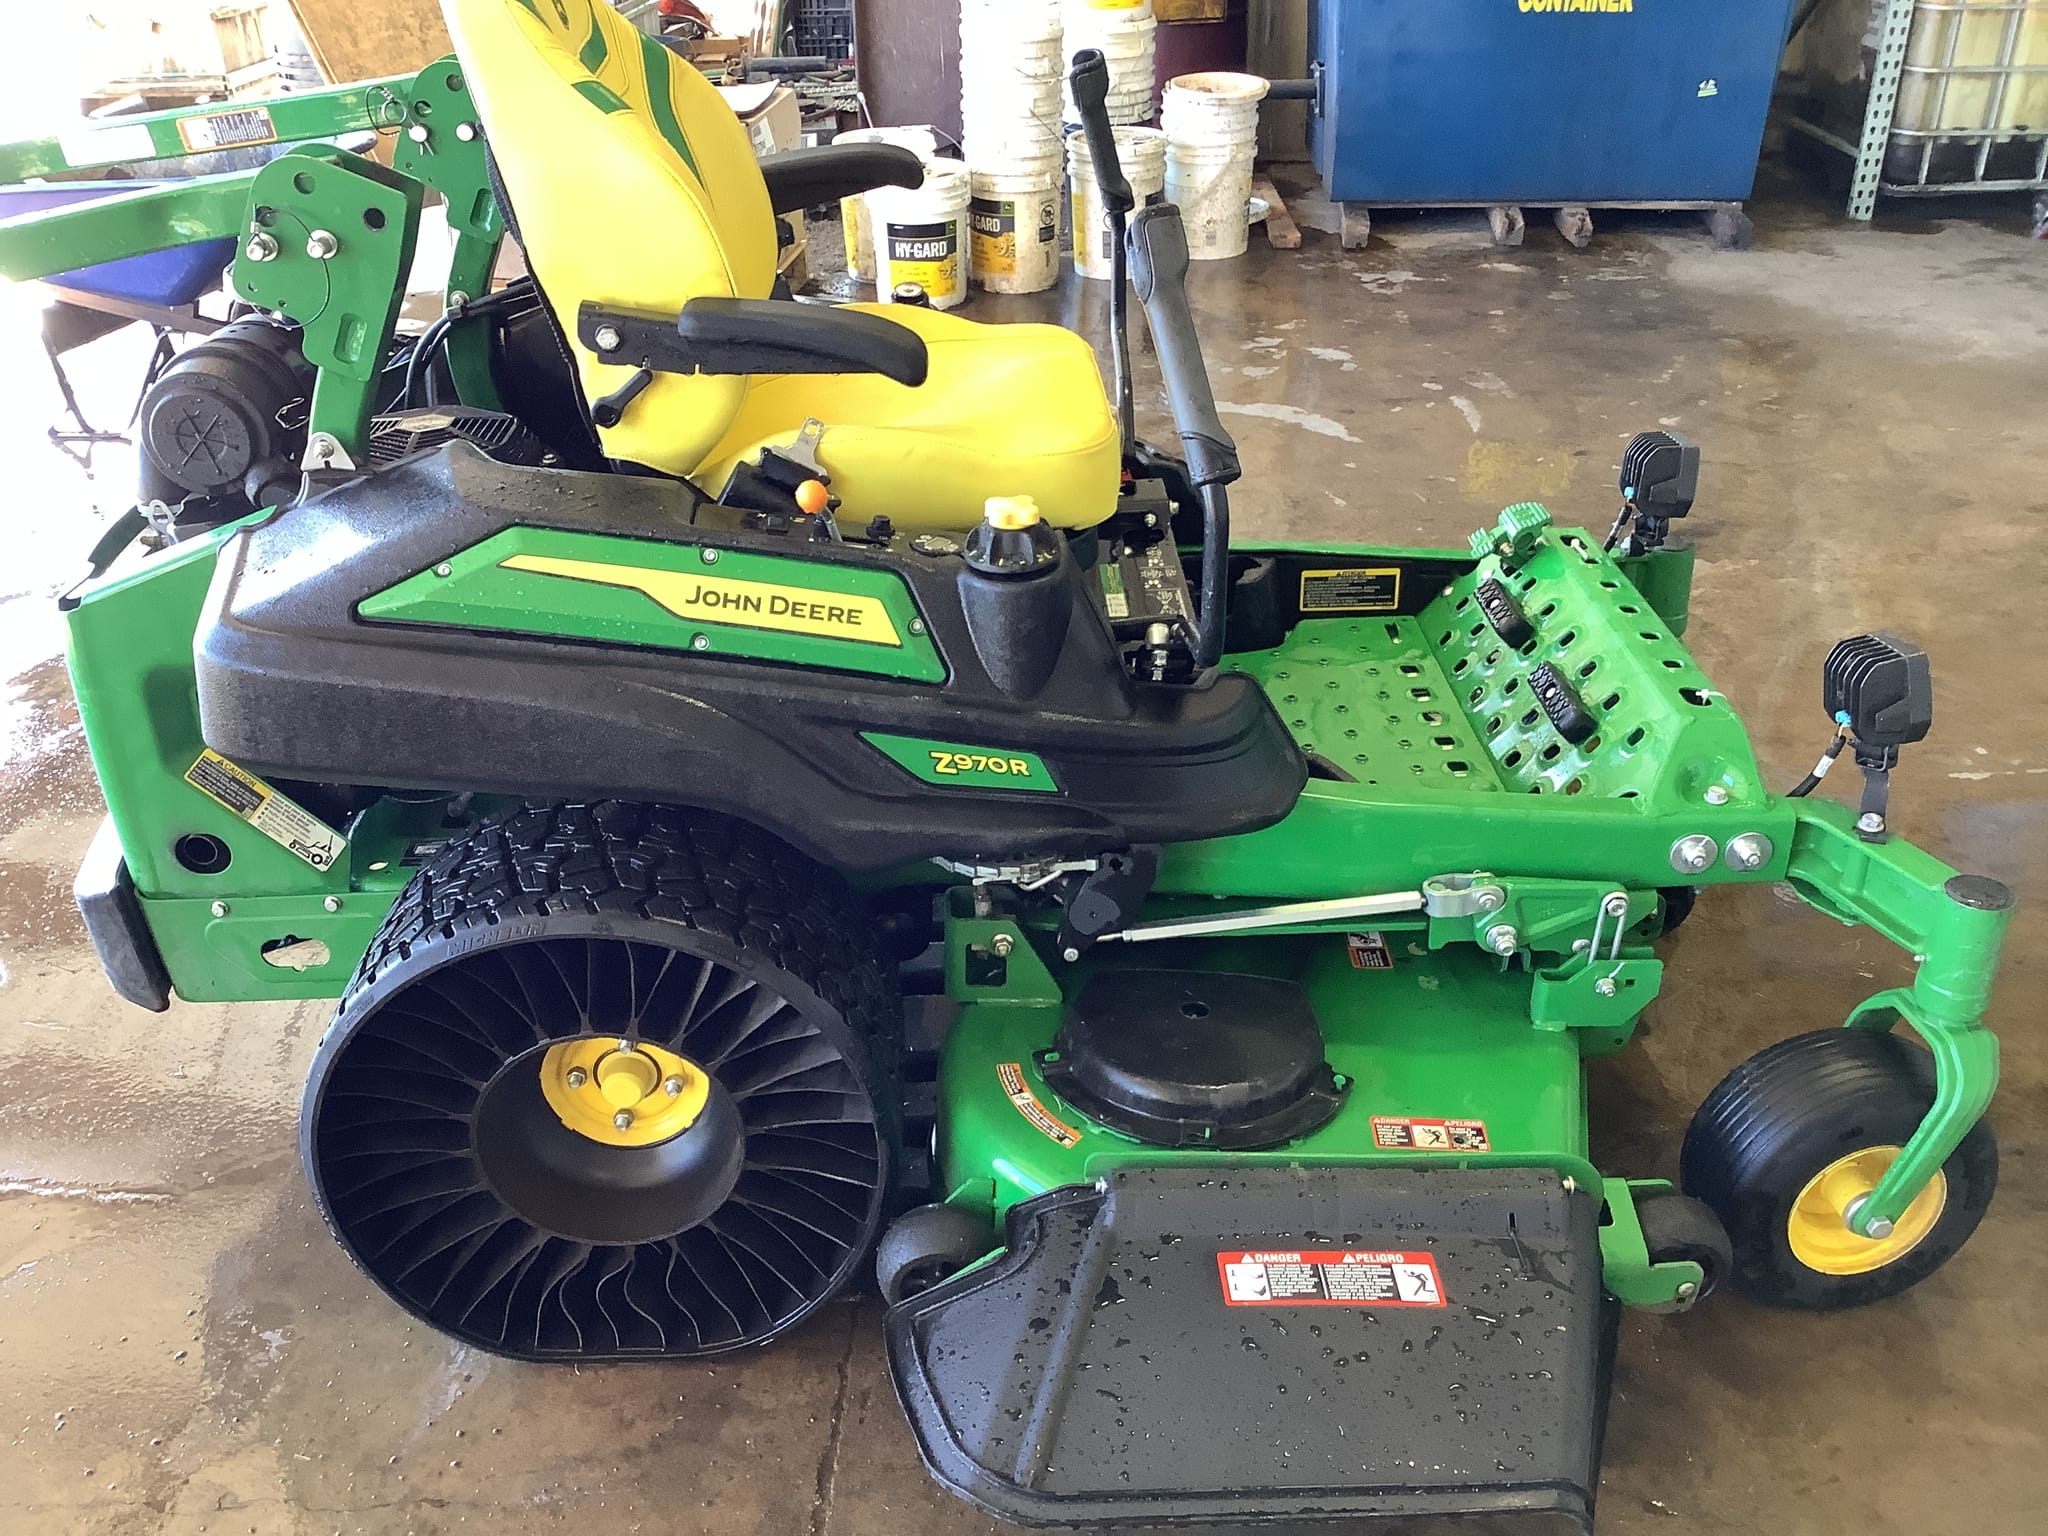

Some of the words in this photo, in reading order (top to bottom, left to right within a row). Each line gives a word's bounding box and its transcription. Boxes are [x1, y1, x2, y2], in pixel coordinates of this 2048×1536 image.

[895, 241, 947, 258] HY-GARD
[930, 751, 1031, 776] Z970R
[223, 762, 257, 788] CAUTION
[447, 922, 547, 956] MICHELIN
[1255, 1253, 1301, 1263] DANGER
[1355, 1253, 1404, 1263] PELIGRO
